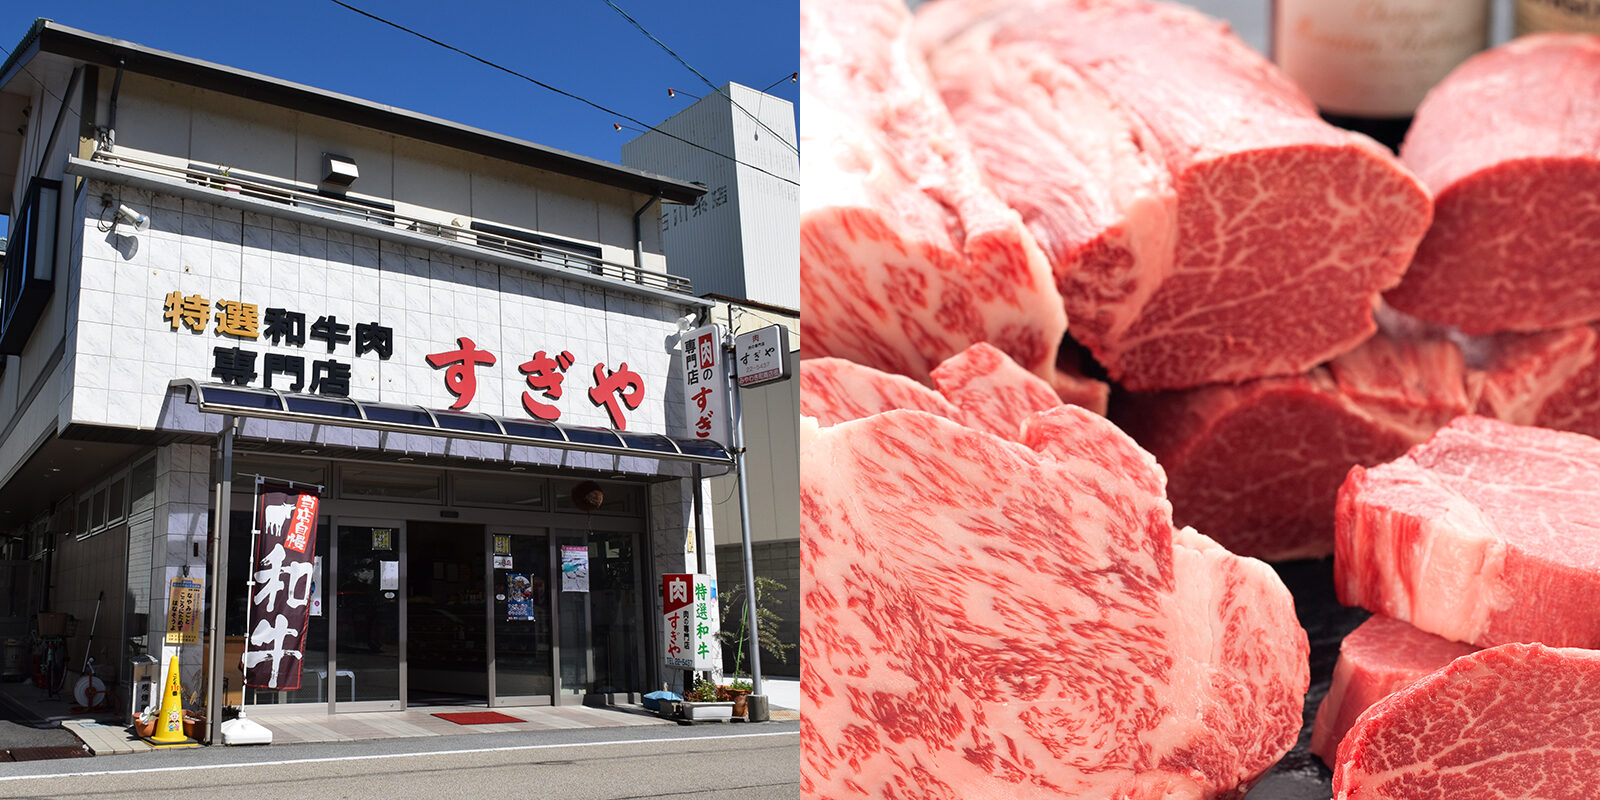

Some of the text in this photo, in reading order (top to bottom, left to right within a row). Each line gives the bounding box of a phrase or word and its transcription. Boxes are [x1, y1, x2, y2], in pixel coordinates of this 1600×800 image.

[163, 291, 393, 360] 特選和牛肉
[211, 346, 351, 398] 専門店
[684, 339, 699, 385] 専門店
[701, 338, 714, 381] 肉の
[740, 347, 775, 365] すぎや
[425, 337, 645, 430] すぎや
[286, 495, 317, 550] 当店自慢
[241, 543, 314, 689] 和牛
[669, 576, 688, 604] 肉
[667, 612, 681, 658] すぎや
[695, 583, 710, 660] 特選和牛
